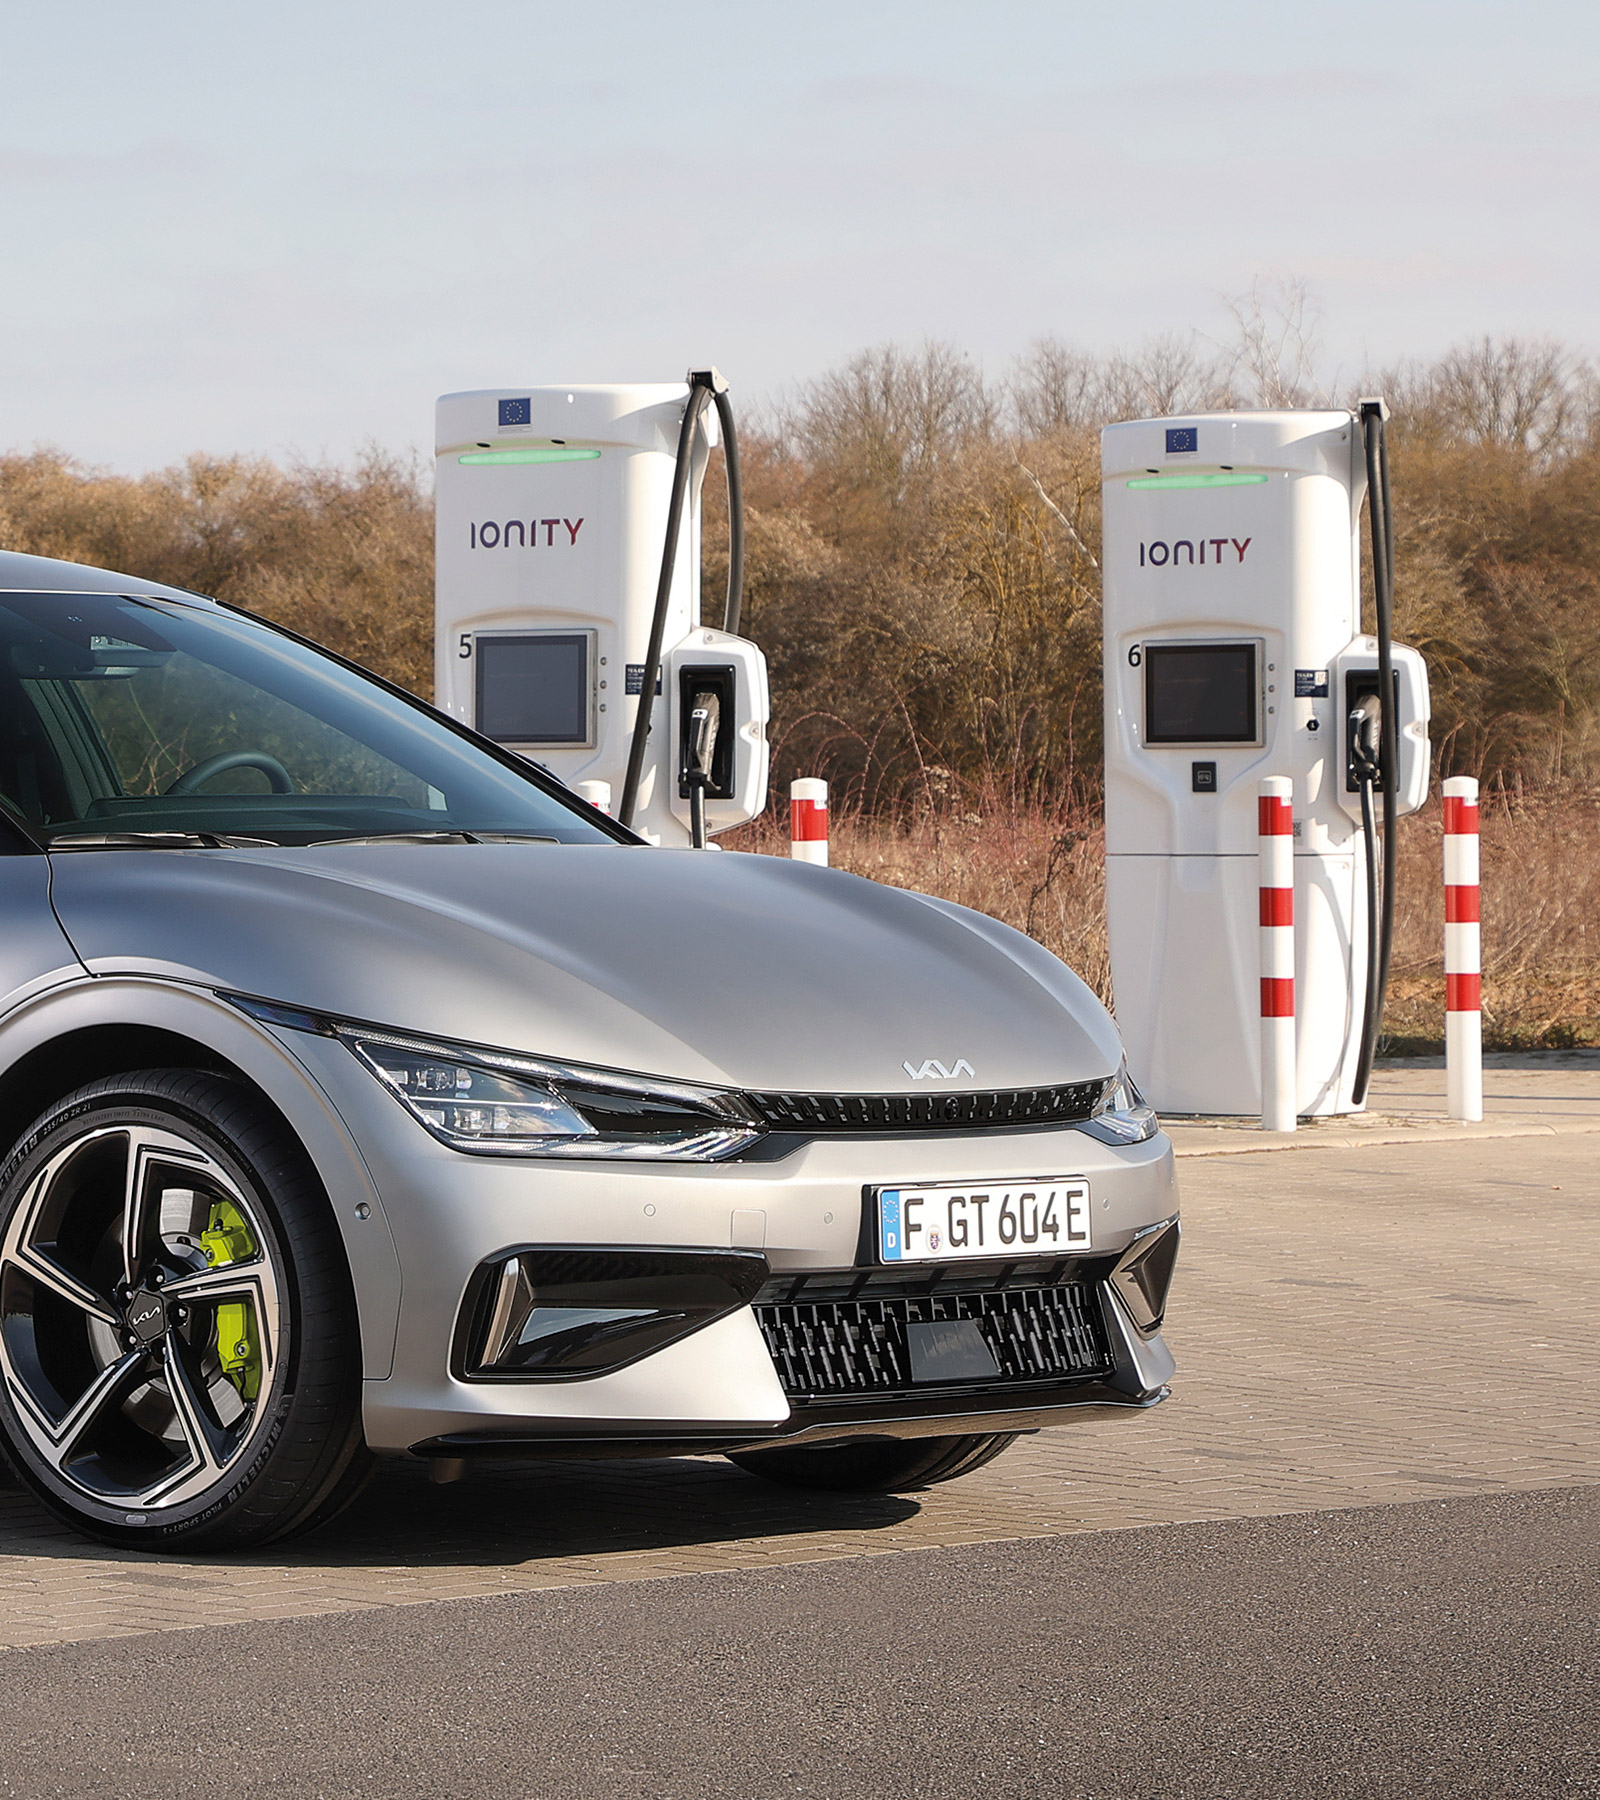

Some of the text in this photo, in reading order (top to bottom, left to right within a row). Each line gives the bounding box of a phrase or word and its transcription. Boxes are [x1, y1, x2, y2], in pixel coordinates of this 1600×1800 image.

[471, 518, 584, 549] IONITY
[1140, 537, 1252, 566] IONITY
[459, 634, 472, 658] 5
[1128, 644, 1141, 667] 6
[43, 1113, 69, 1136] 255/40
[904, 1198, 924, 1250] F
[948, 1195, 990, 1247] GT
[887, 1231, 896, 1248] D
[227, 1422, 281, 1503] MICHELIN
